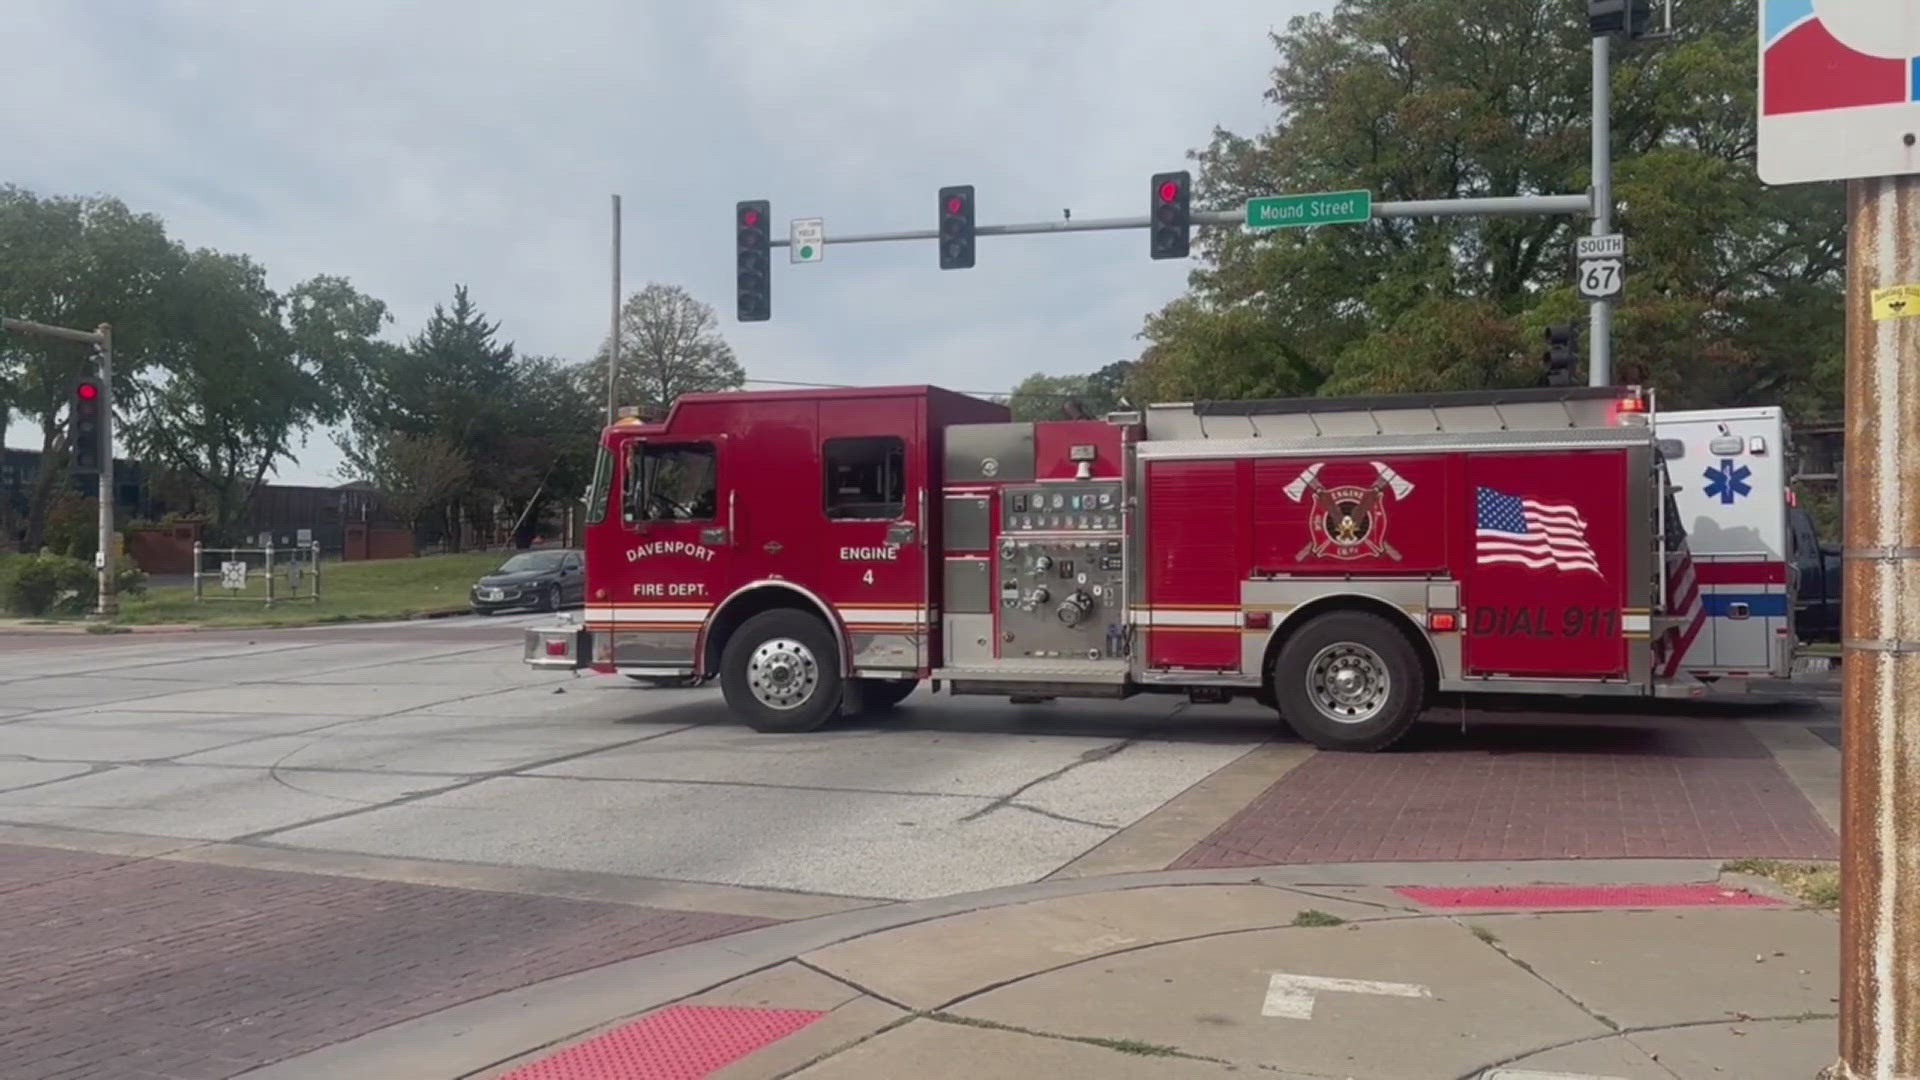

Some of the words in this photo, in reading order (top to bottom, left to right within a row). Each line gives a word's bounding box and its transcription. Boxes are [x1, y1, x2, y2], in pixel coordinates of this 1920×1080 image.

[1260, 203, 1304, 220] Mound
[1310, 199, 1355, 217] Street
[1579, 239, 1623, 253] SOUTH
[1585, 266, 1616, 289] 67
[626, 541, 716, 563] DAVENPORT
[840, 546, 897, 560] ENGINE
[862, 569, 875, 585] 4
[634, 583, 666, 596] FIRE
[668, 583, 709, 596] DEPT.
[1472, 605, 1554, 638] DIAL
[1561, 606, 1619, 638] 911
